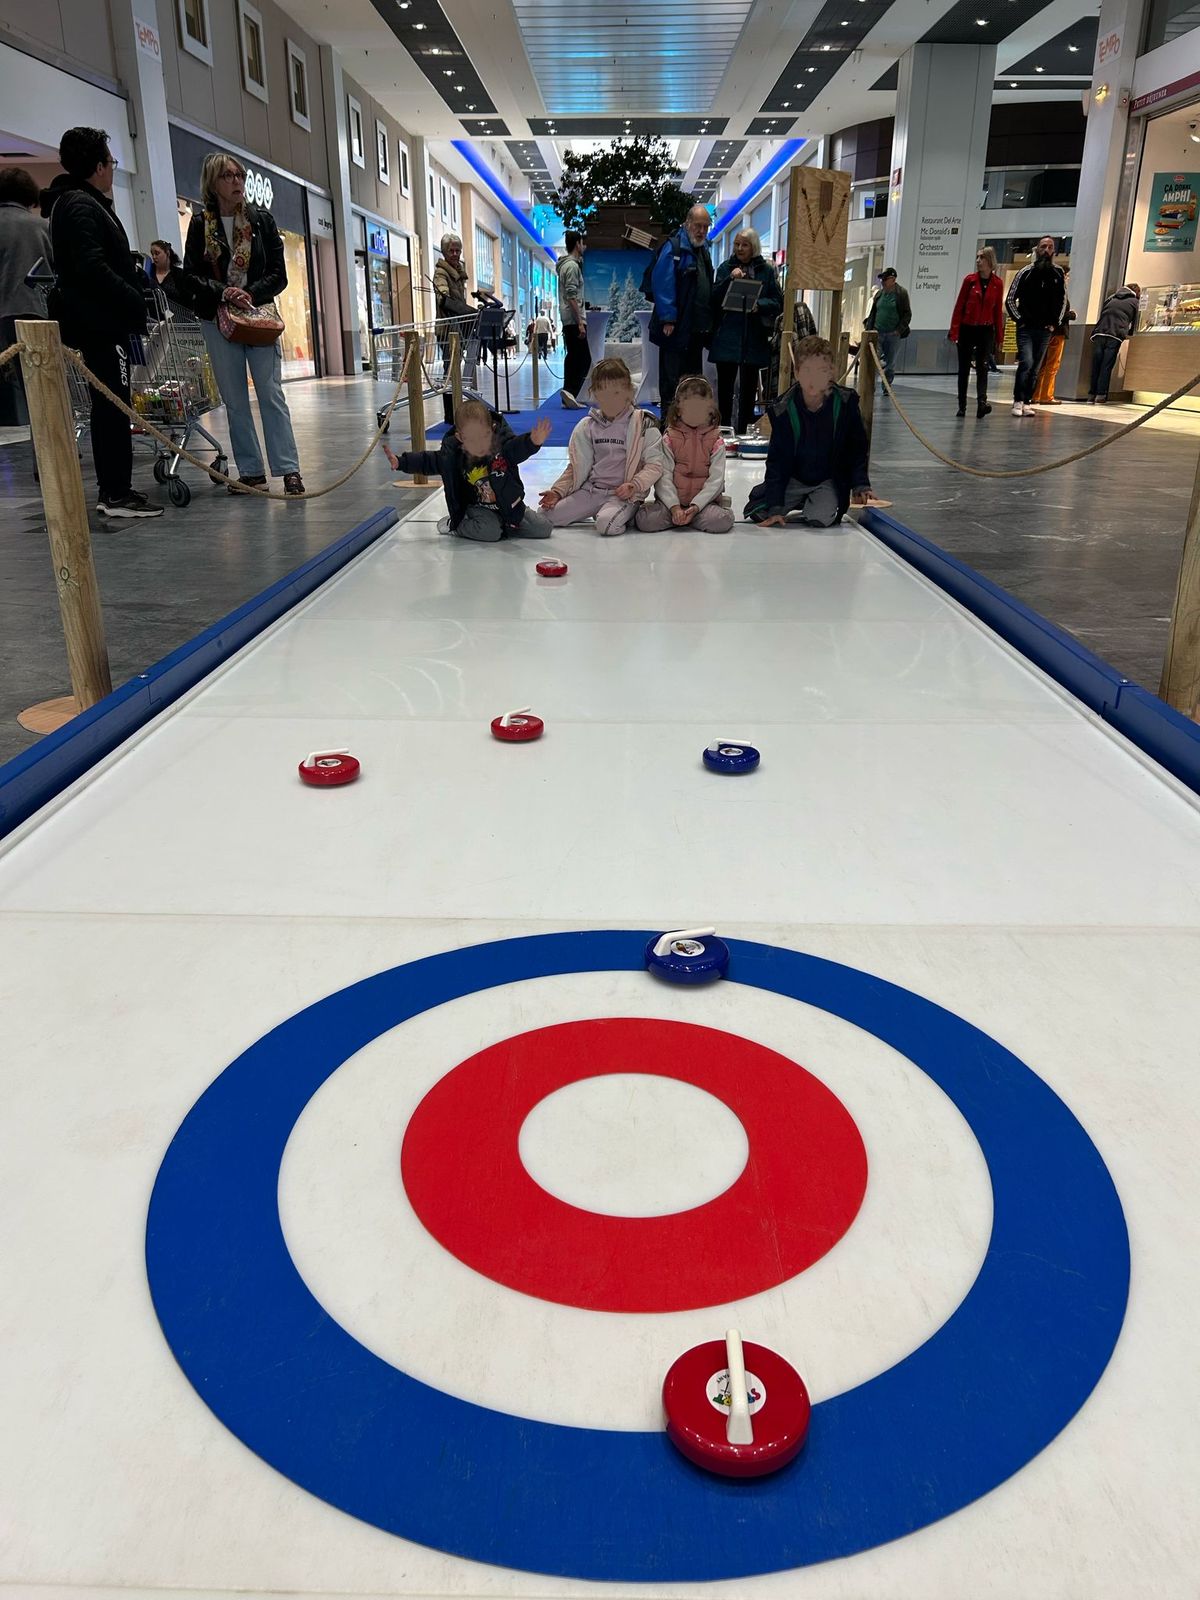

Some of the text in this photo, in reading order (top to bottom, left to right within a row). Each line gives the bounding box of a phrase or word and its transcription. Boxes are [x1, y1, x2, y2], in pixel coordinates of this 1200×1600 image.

[1162, 189, 1191, 202] AMPHI
[919, 243, 944, 251] Orchestra
[118, 359, 129, 387] asics
